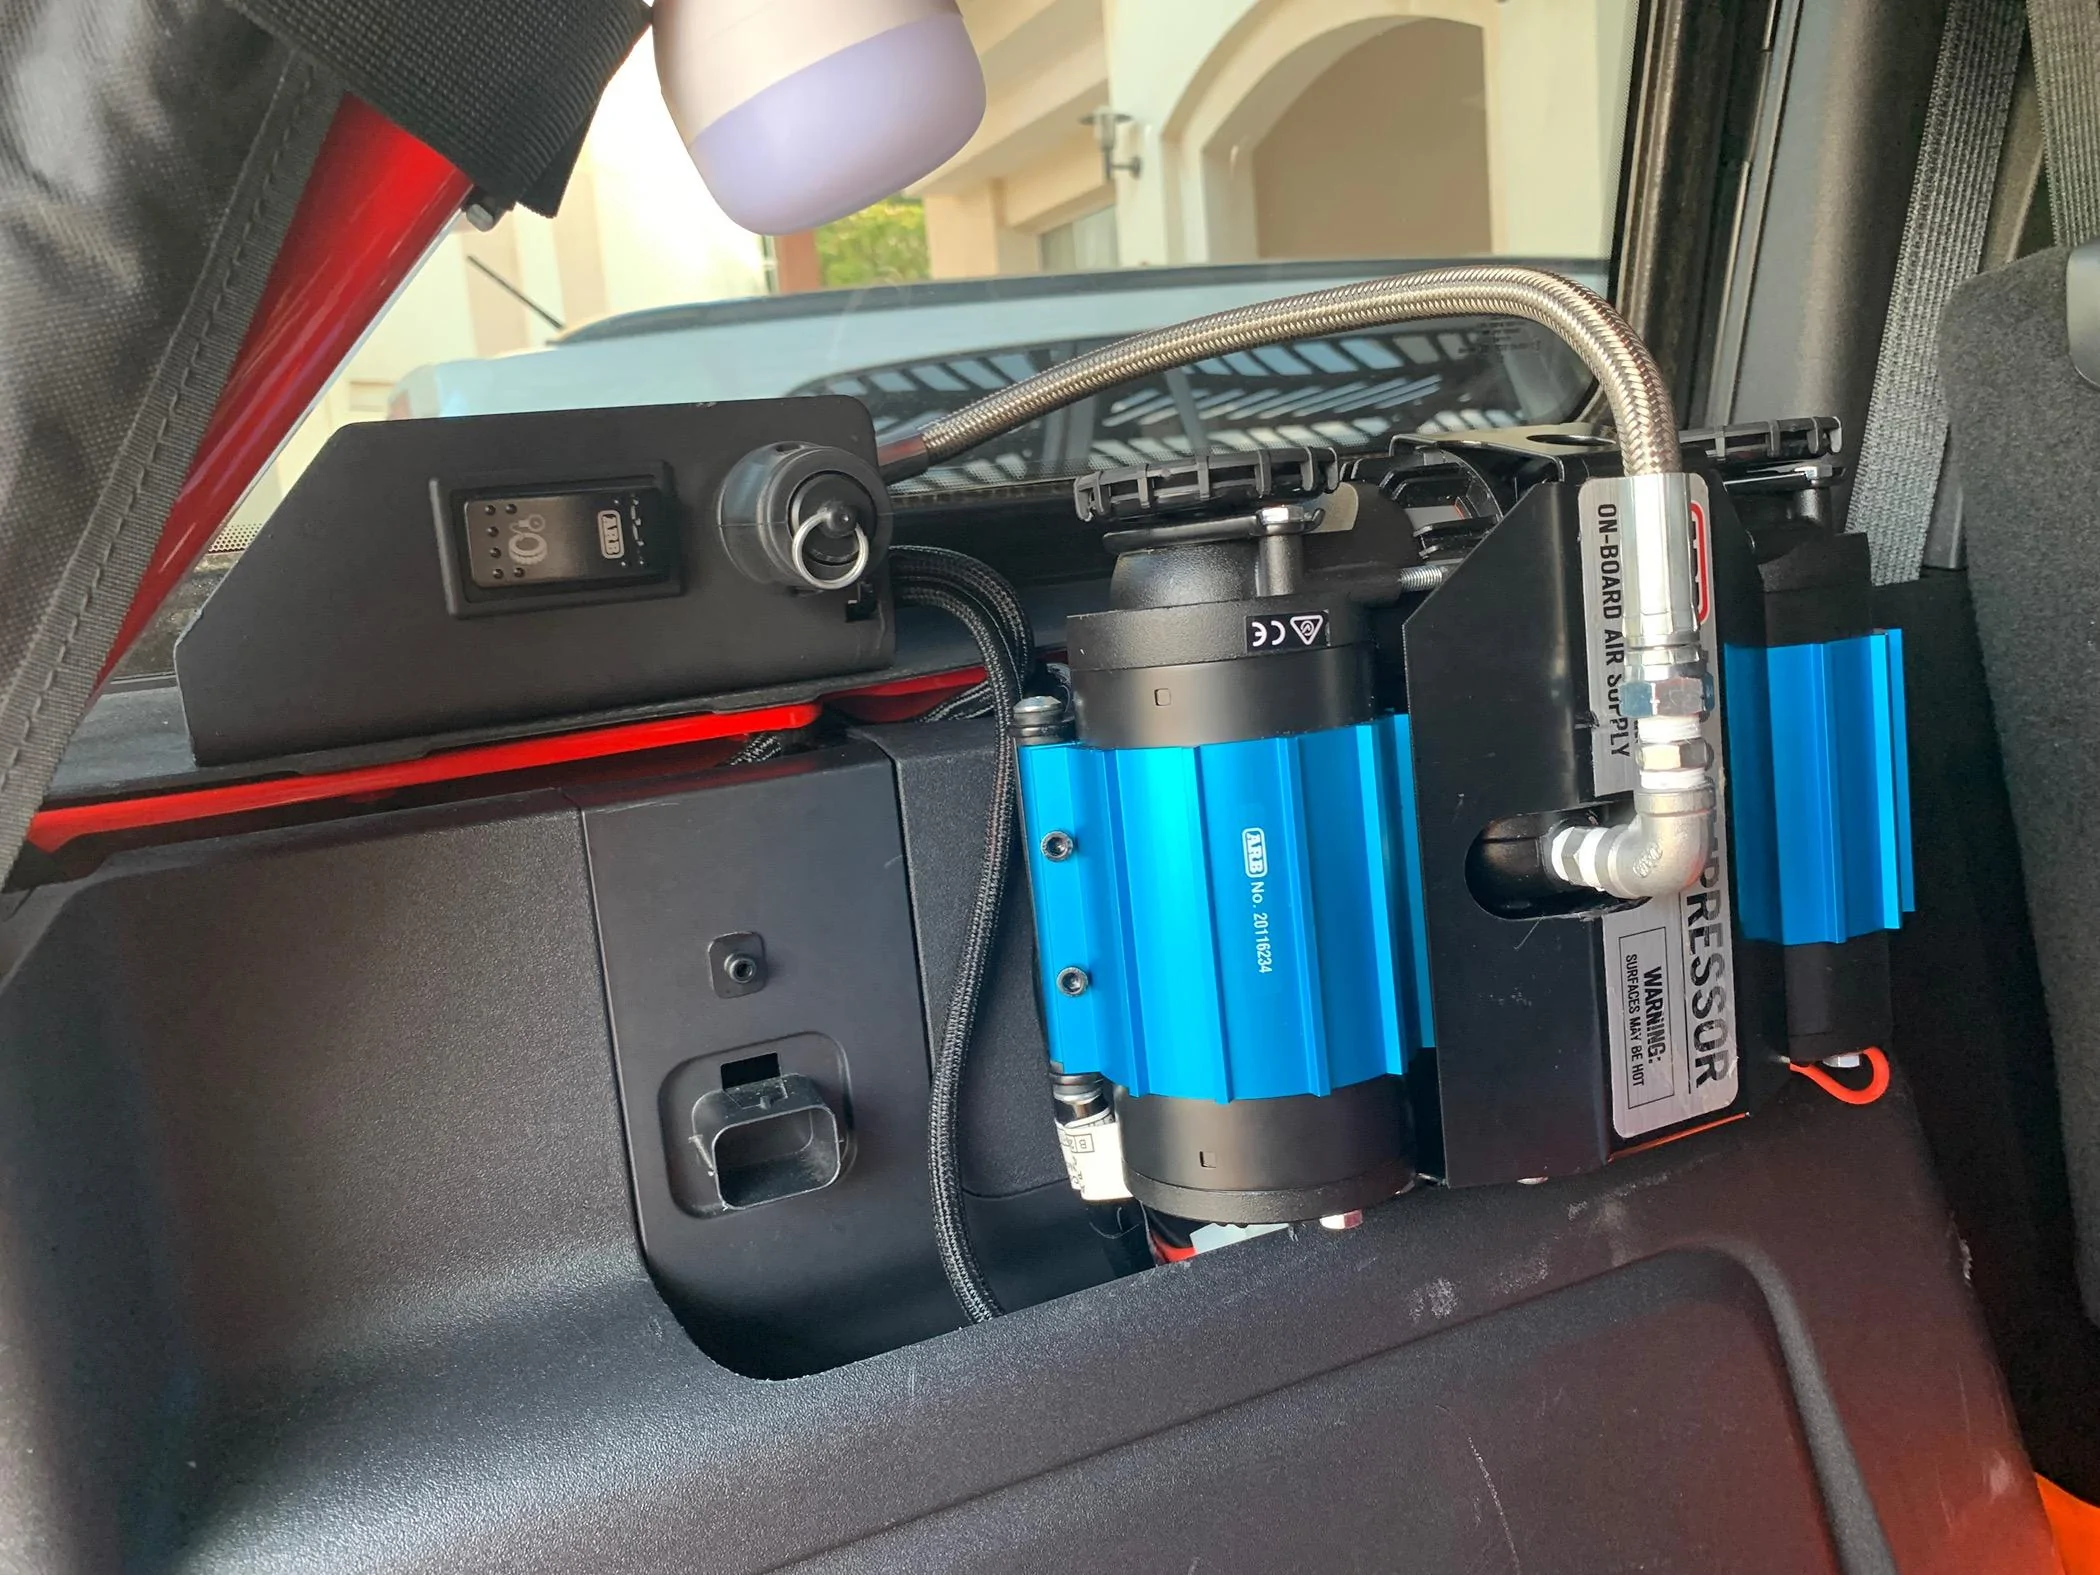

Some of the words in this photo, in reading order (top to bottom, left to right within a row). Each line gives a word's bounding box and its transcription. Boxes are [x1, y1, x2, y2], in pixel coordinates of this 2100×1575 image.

[600, 513, 622, 557] ARB
[1597, 503, 1623, 620] ON-BOARD
[1251, 620, 1286, 647] CE
[1605, 628, 1625, 666] AIR
[1243, 829, 1267, 877] ARB
[1251, 881, 1265, 908] No.
[1253, 912, 1273, 973] 20116234
[1626, 954, 1640, 1014] SURFACES
[1629, 1015, 1642, 1042] MAY
[1643, 966, 1666, 1064] WARNING:
[1631, 1045, 1643, 1062] BE
[1632, 1064, 1645, 1087] HOT
